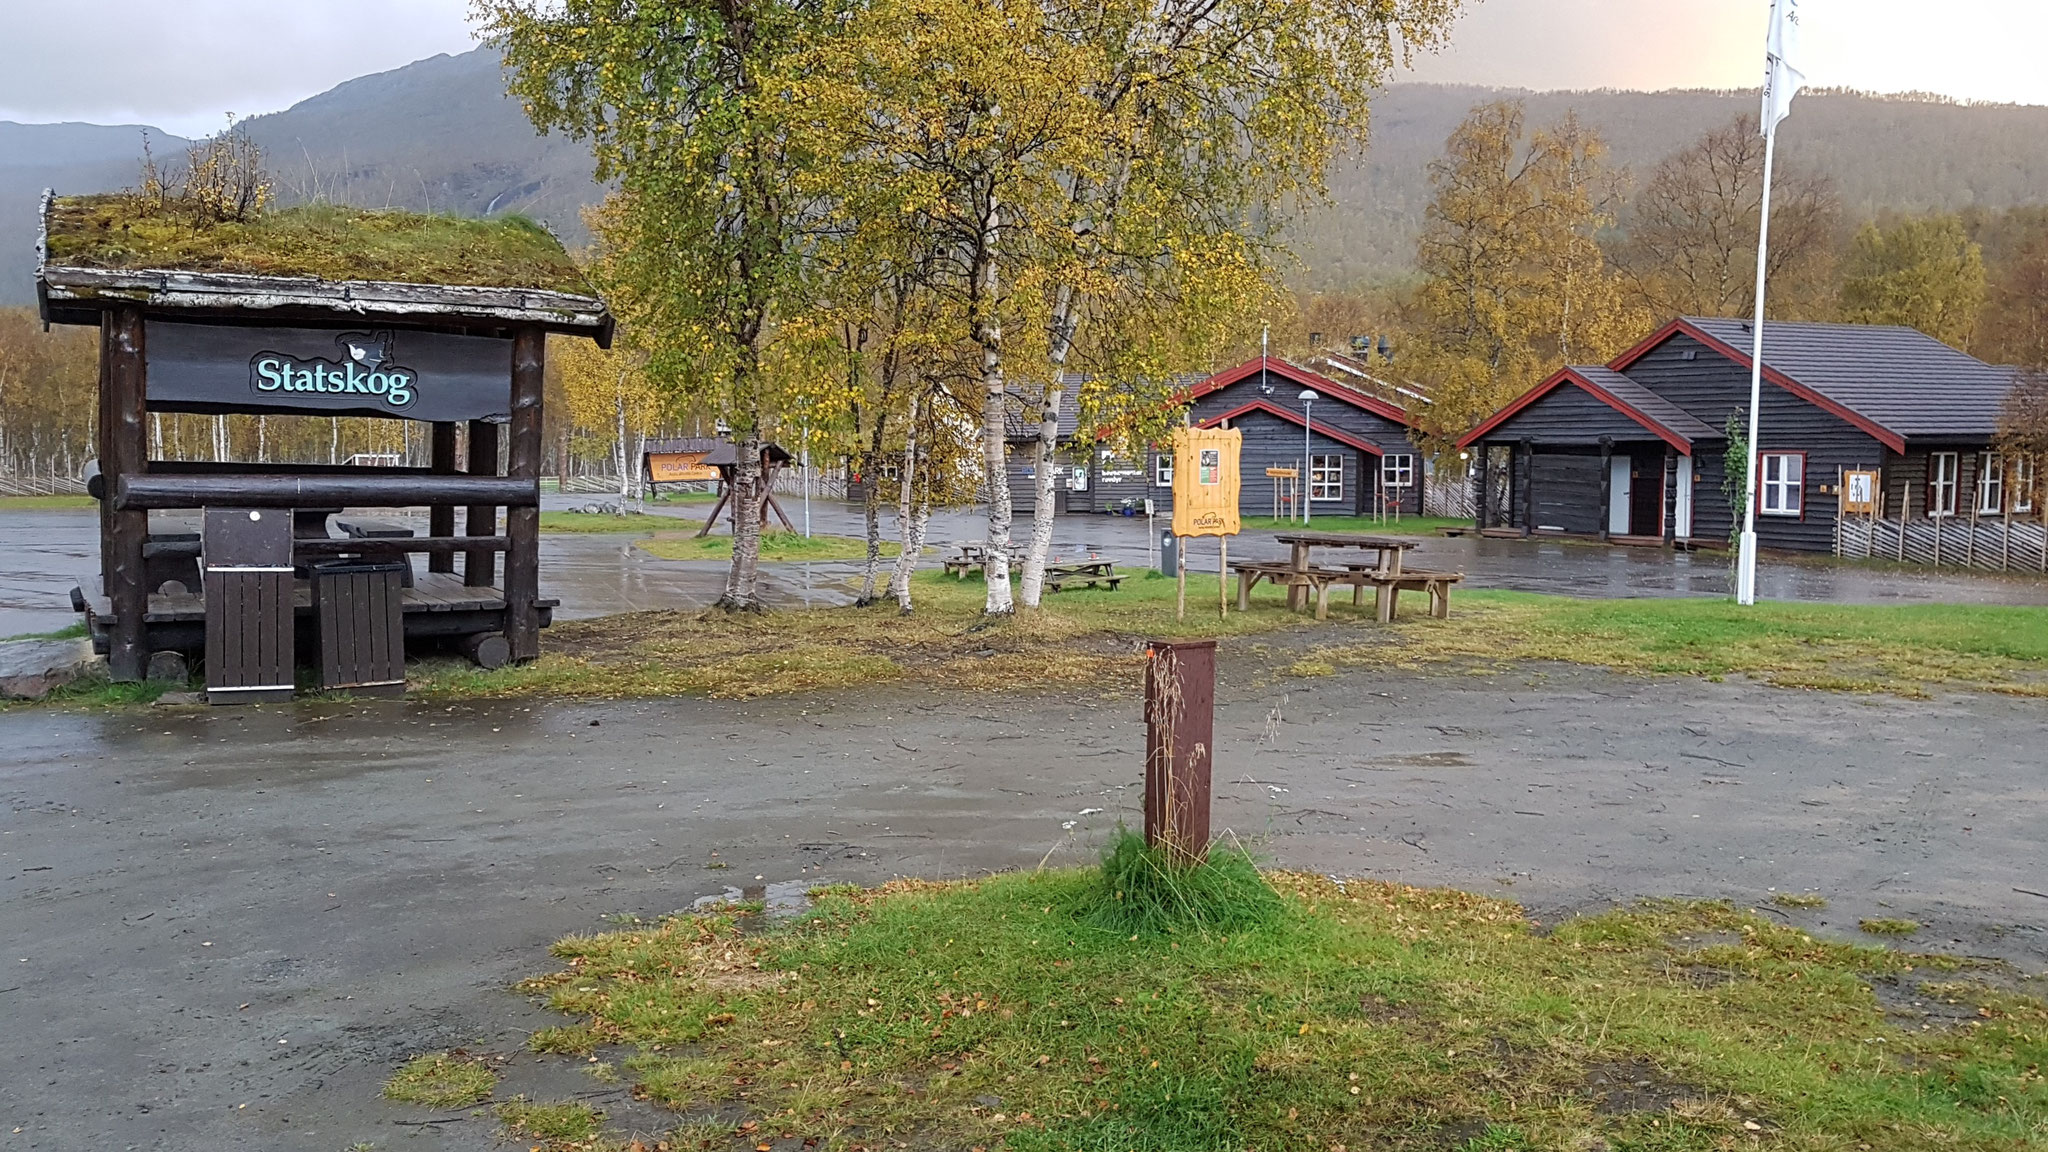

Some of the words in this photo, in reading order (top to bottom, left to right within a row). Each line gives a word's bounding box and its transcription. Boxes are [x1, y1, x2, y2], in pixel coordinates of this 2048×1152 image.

[257, 359, 410, 405] Statskog
[661, 463, 688, 472] POLAR
[1193, 518, 1211, 526] POLAR
